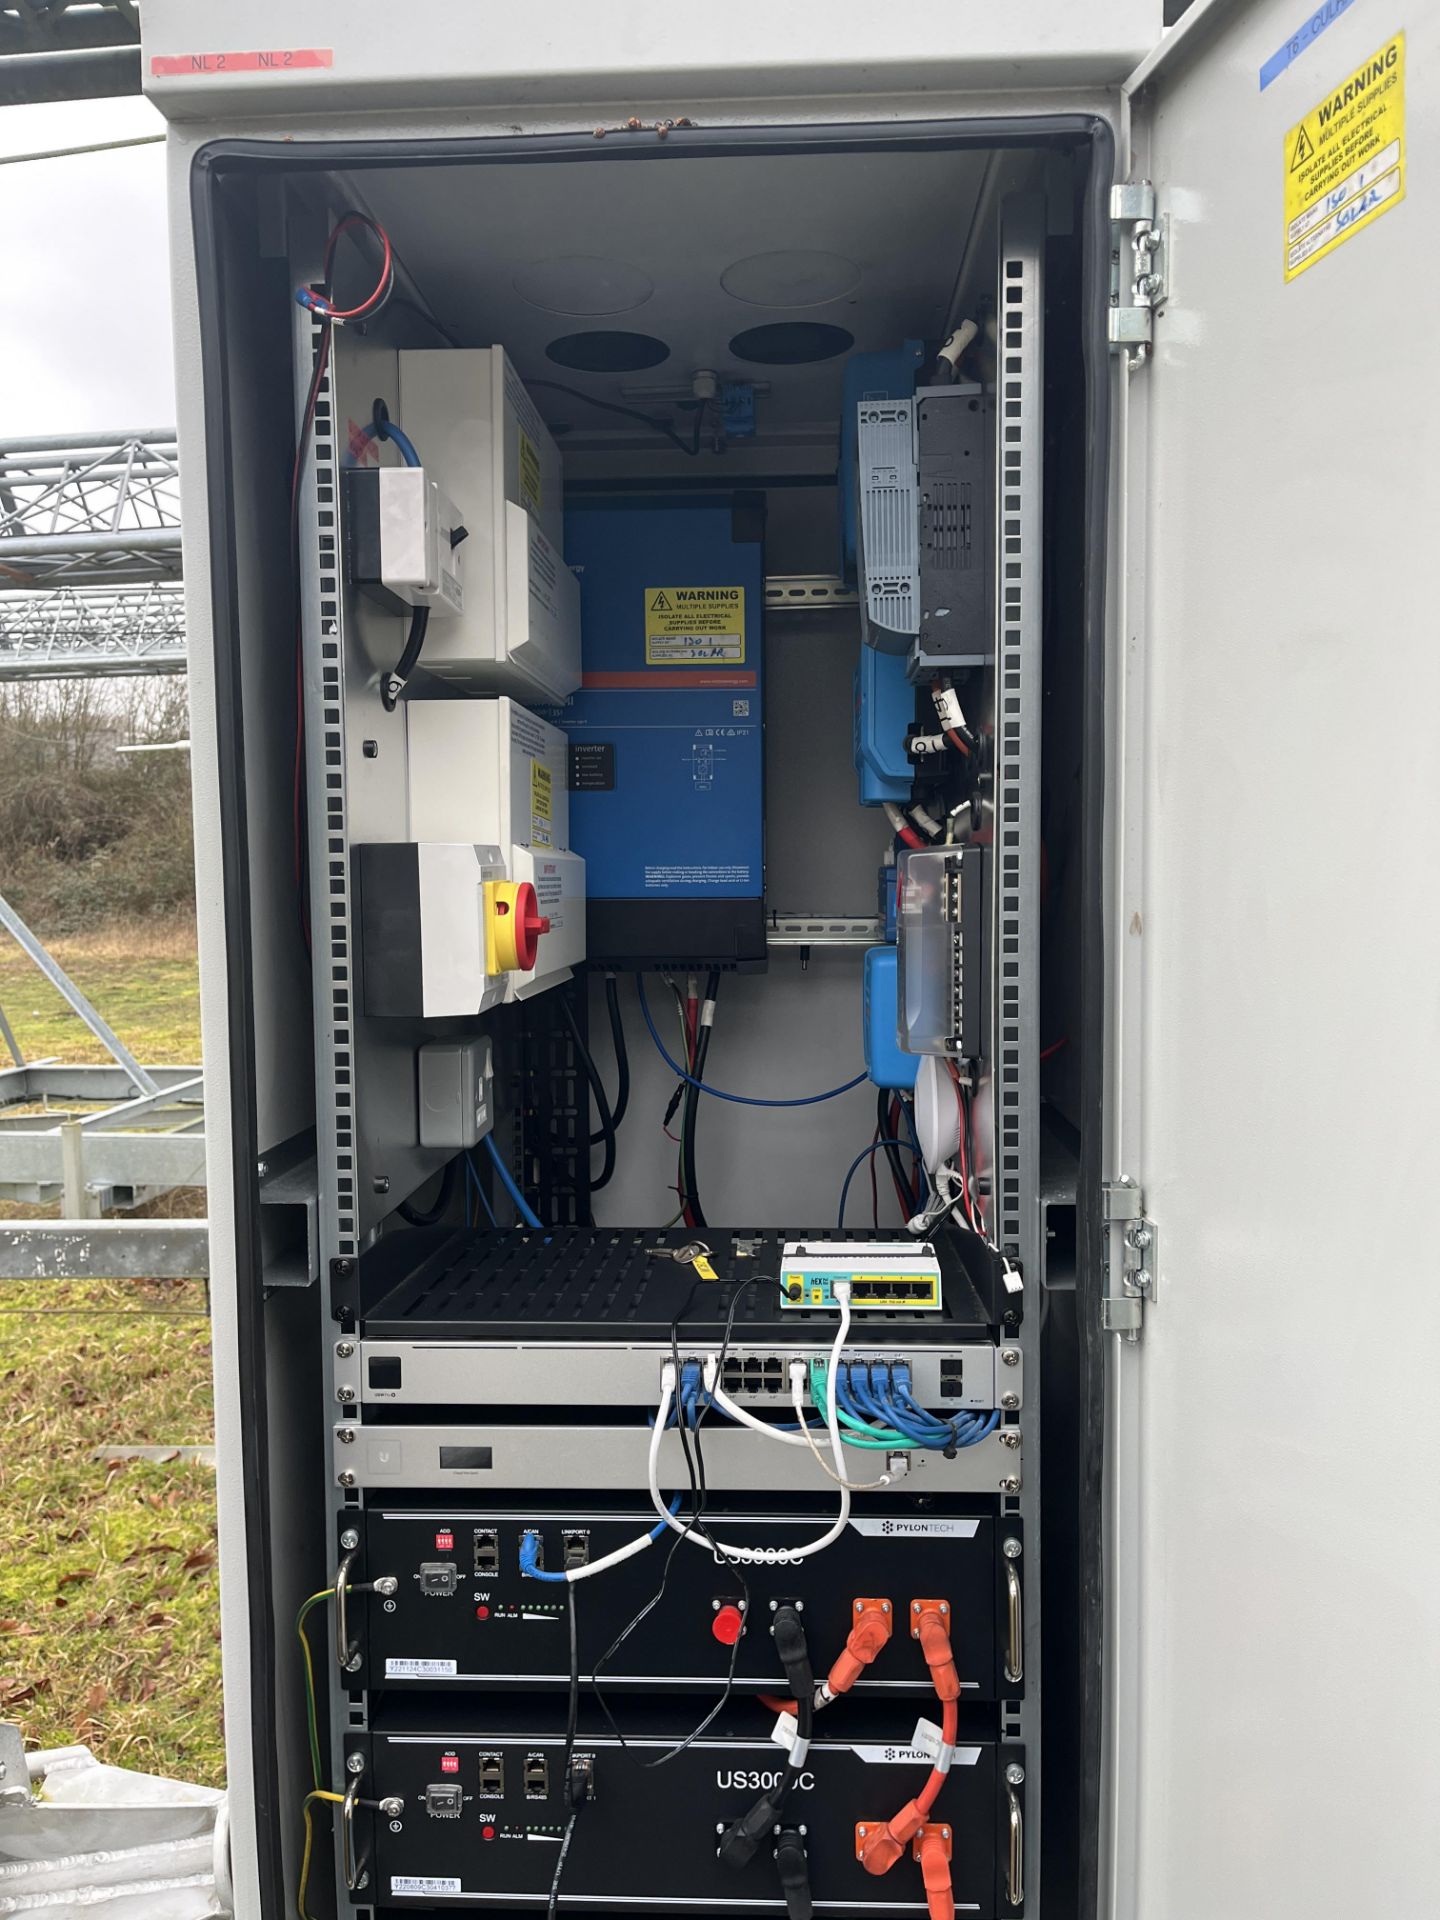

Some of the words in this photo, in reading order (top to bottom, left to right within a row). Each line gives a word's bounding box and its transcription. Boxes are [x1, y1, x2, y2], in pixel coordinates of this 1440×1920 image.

[191, 55, 210, 70] NL
[216, 55, 226, 69] 2
[258, 53, 278, 67] NL
[283, 51, 293, 66] 2
[1318, 44, 1397, 127] WARNING
[1319, 106, 1355, 145] MULTIPLE
[1357, 71, 1398, 114] SUPPLIES
[1298, 153, 1326, 183] ISOLATE
[1328, 143, 1340, 158] ALL
[1342, 103, 1387, 146] ELECTRICAL
[1310, 152, 1344, 185] SUPPLIES
[1345, 127, 1373, 156] BEFORE
[1304, 168, 1340, 201] CARRYING
[1341, 153, 1356, 171] OUT
[1358, 133, 1381, 158] WORK
[676, 590, 739, 600] WARNING
[896, 1523, 954, 1532] PYLONTECH
[473, 1593, 491, 1601] SW
[479, 1814, 496, 1823] SW
